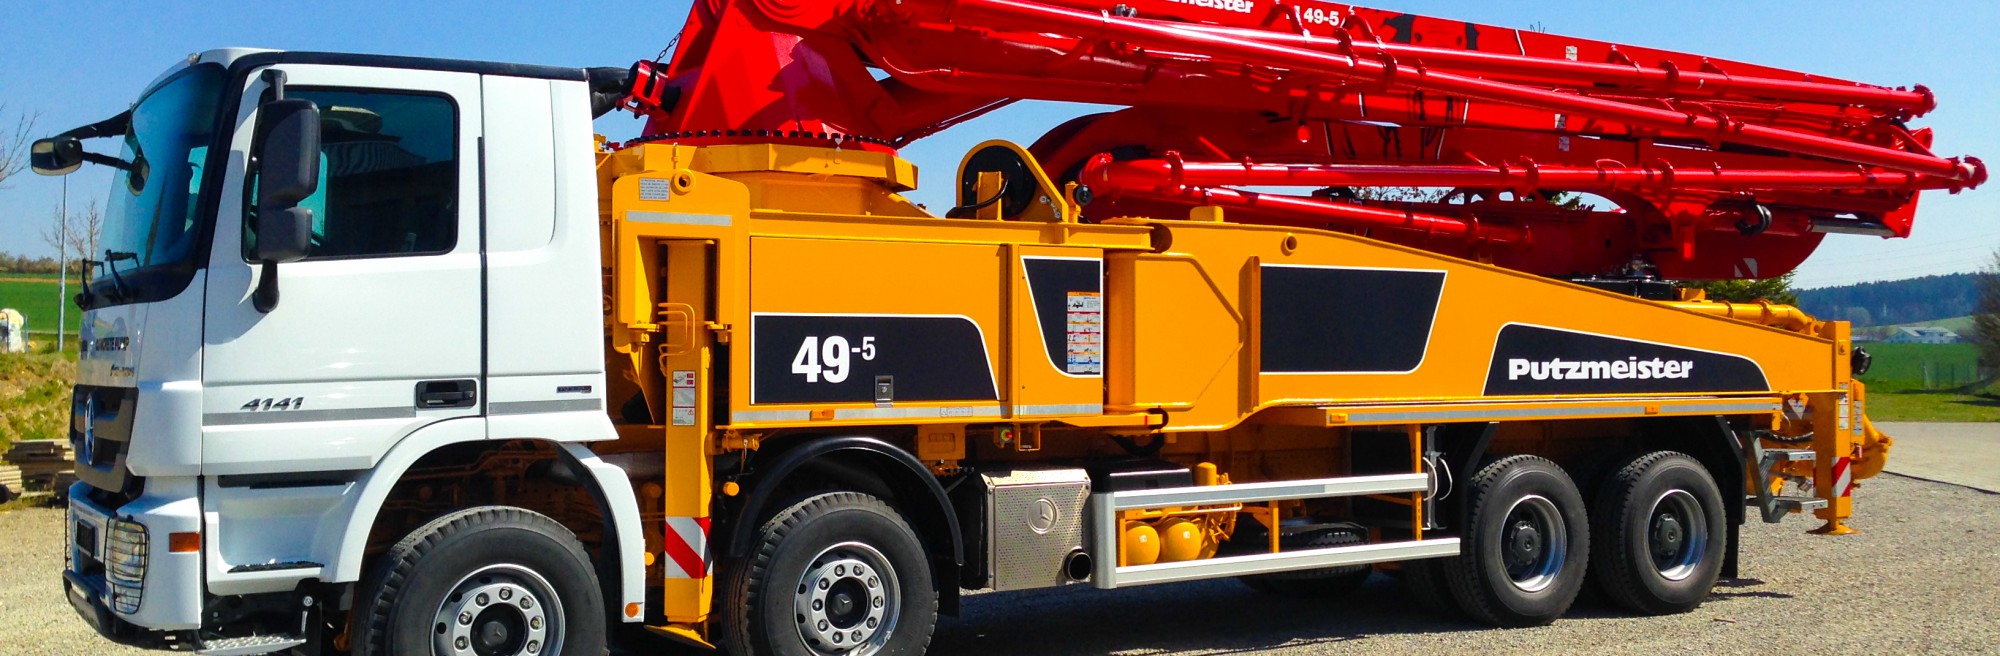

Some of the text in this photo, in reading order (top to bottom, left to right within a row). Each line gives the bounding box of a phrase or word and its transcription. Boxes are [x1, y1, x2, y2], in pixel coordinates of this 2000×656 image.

[1303, 7, 1340, 26] 49-5
[791, 335, 876, 384] 49-5
[1508, 356, 1693, 380] Putzmeister
[240, 397, 304, 412] 4141
